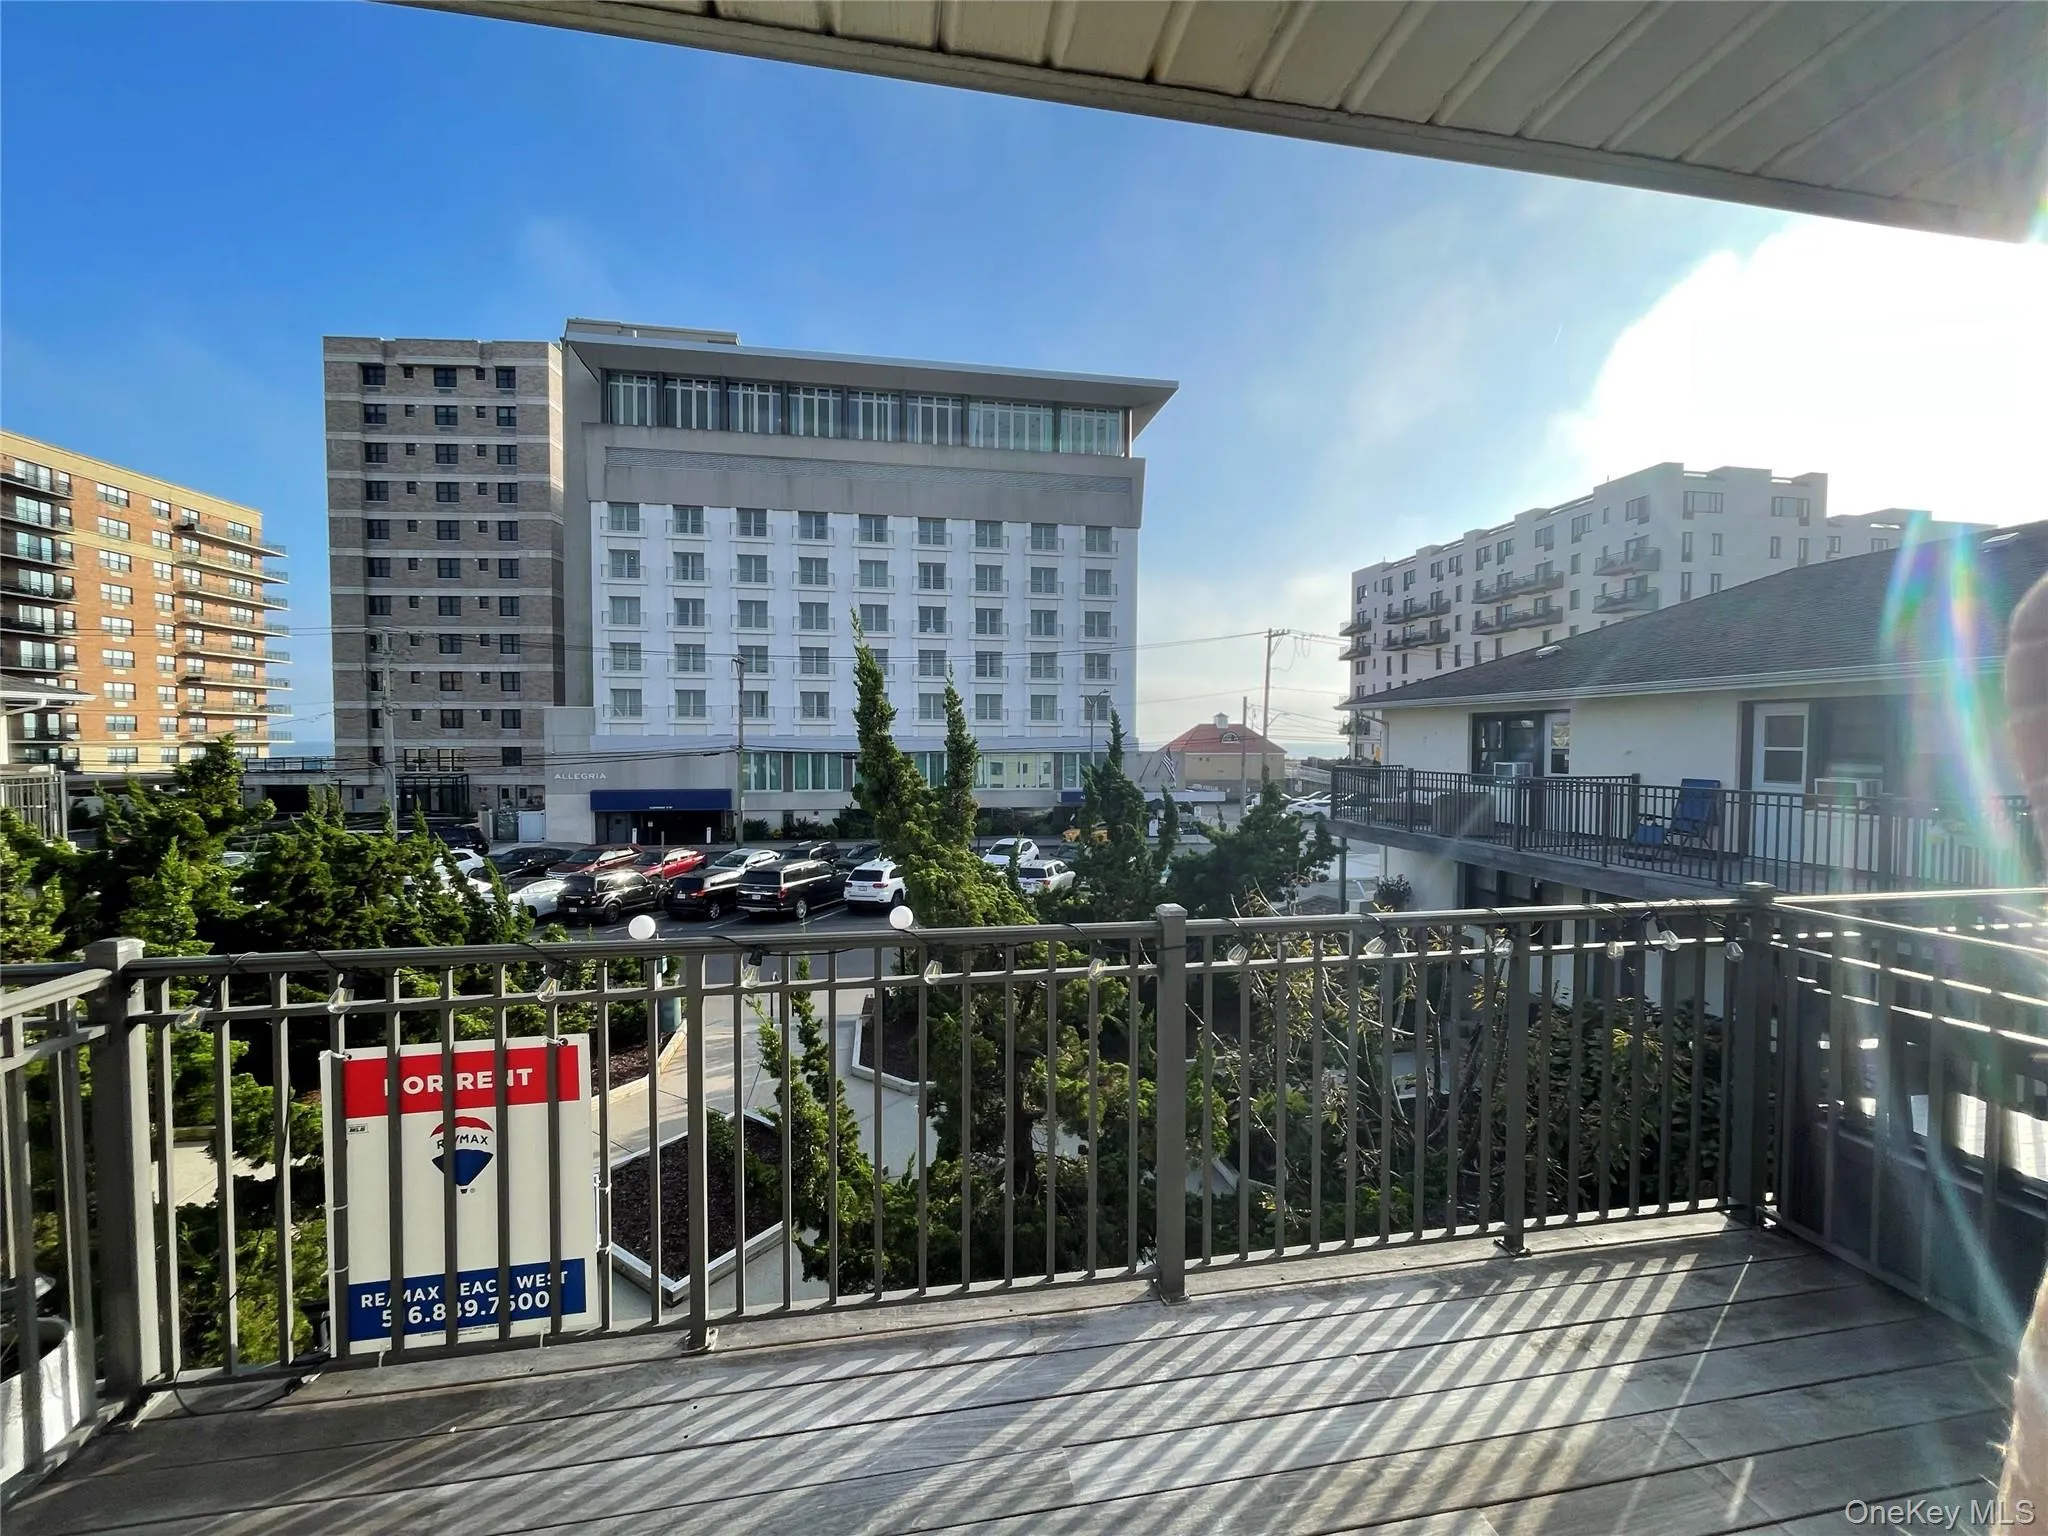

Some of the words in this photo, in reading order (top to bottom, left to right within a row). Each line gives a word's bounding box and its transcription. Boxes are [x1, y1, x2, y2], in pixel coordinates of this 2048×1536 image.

[384, 1076, 449, 1096] OR
[436, 1134, 489, 1149] R/MAX
[447, 1278, 509, 1297] EAC
[382, 1290, 550, 1328] 56.89.700
